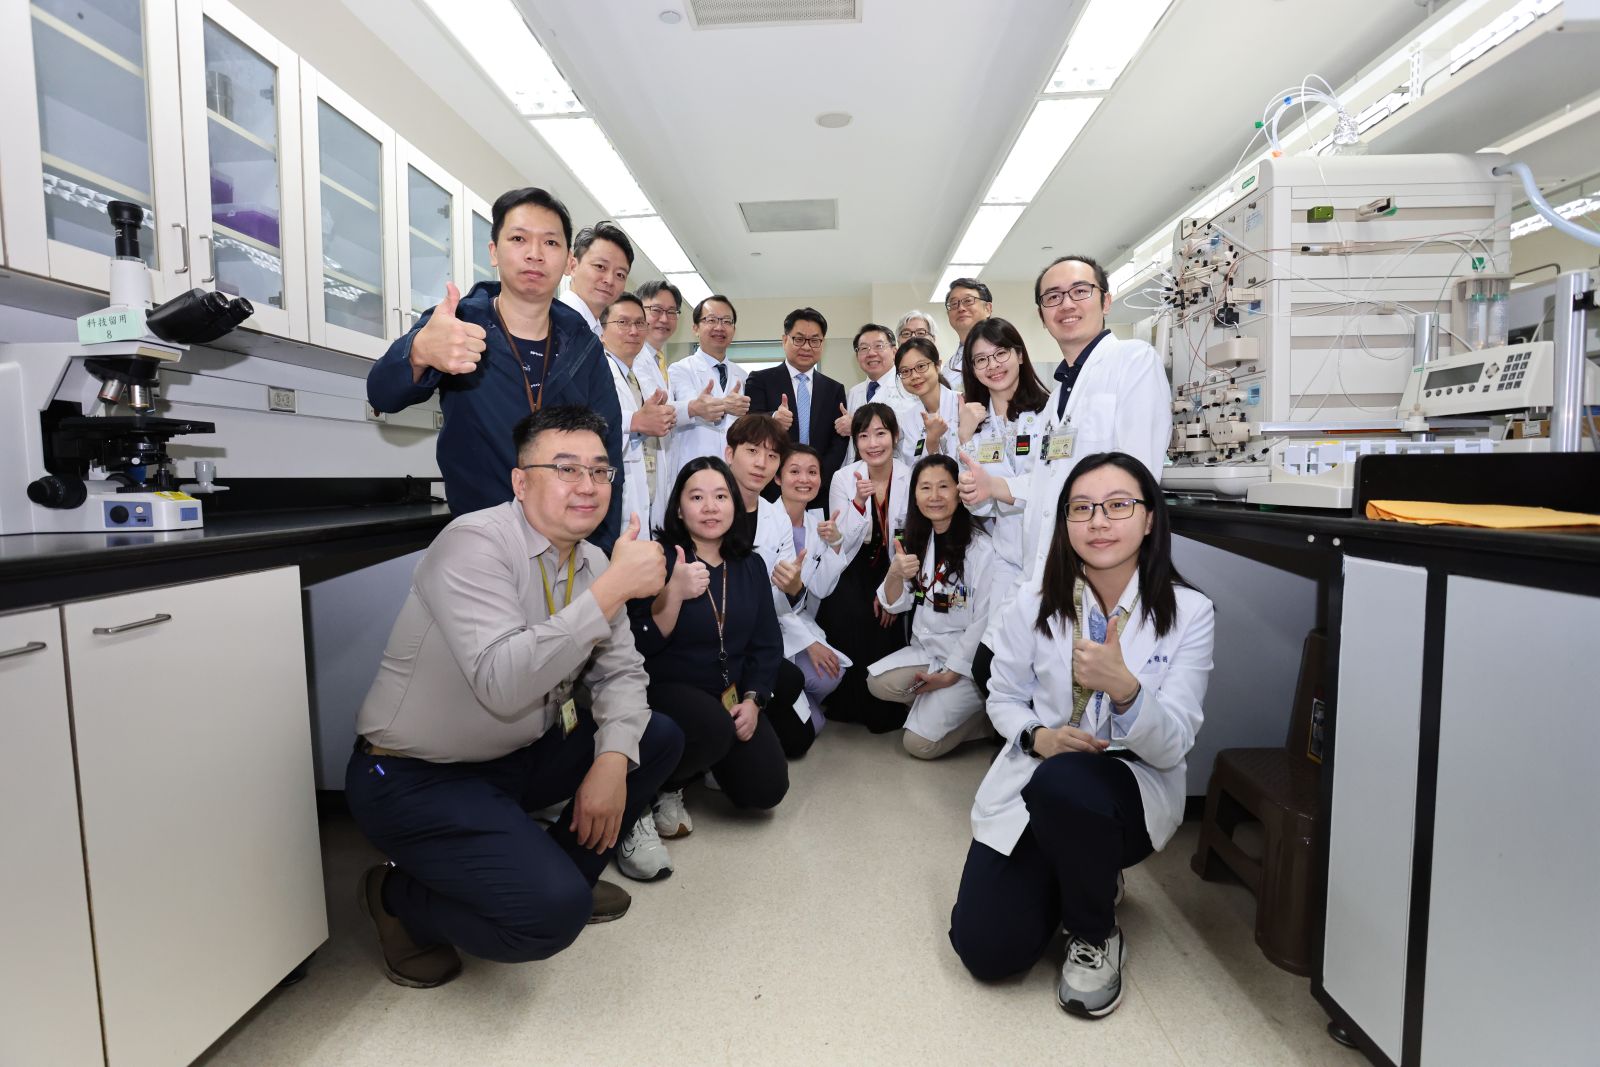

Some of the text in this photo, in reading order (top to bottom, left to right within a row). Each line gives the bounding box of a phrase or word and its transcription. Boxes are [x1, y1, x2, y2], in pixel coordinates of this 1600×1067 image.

[87, 314, 127, 328] 科技留用
[106, 329, 113, 340] 8
